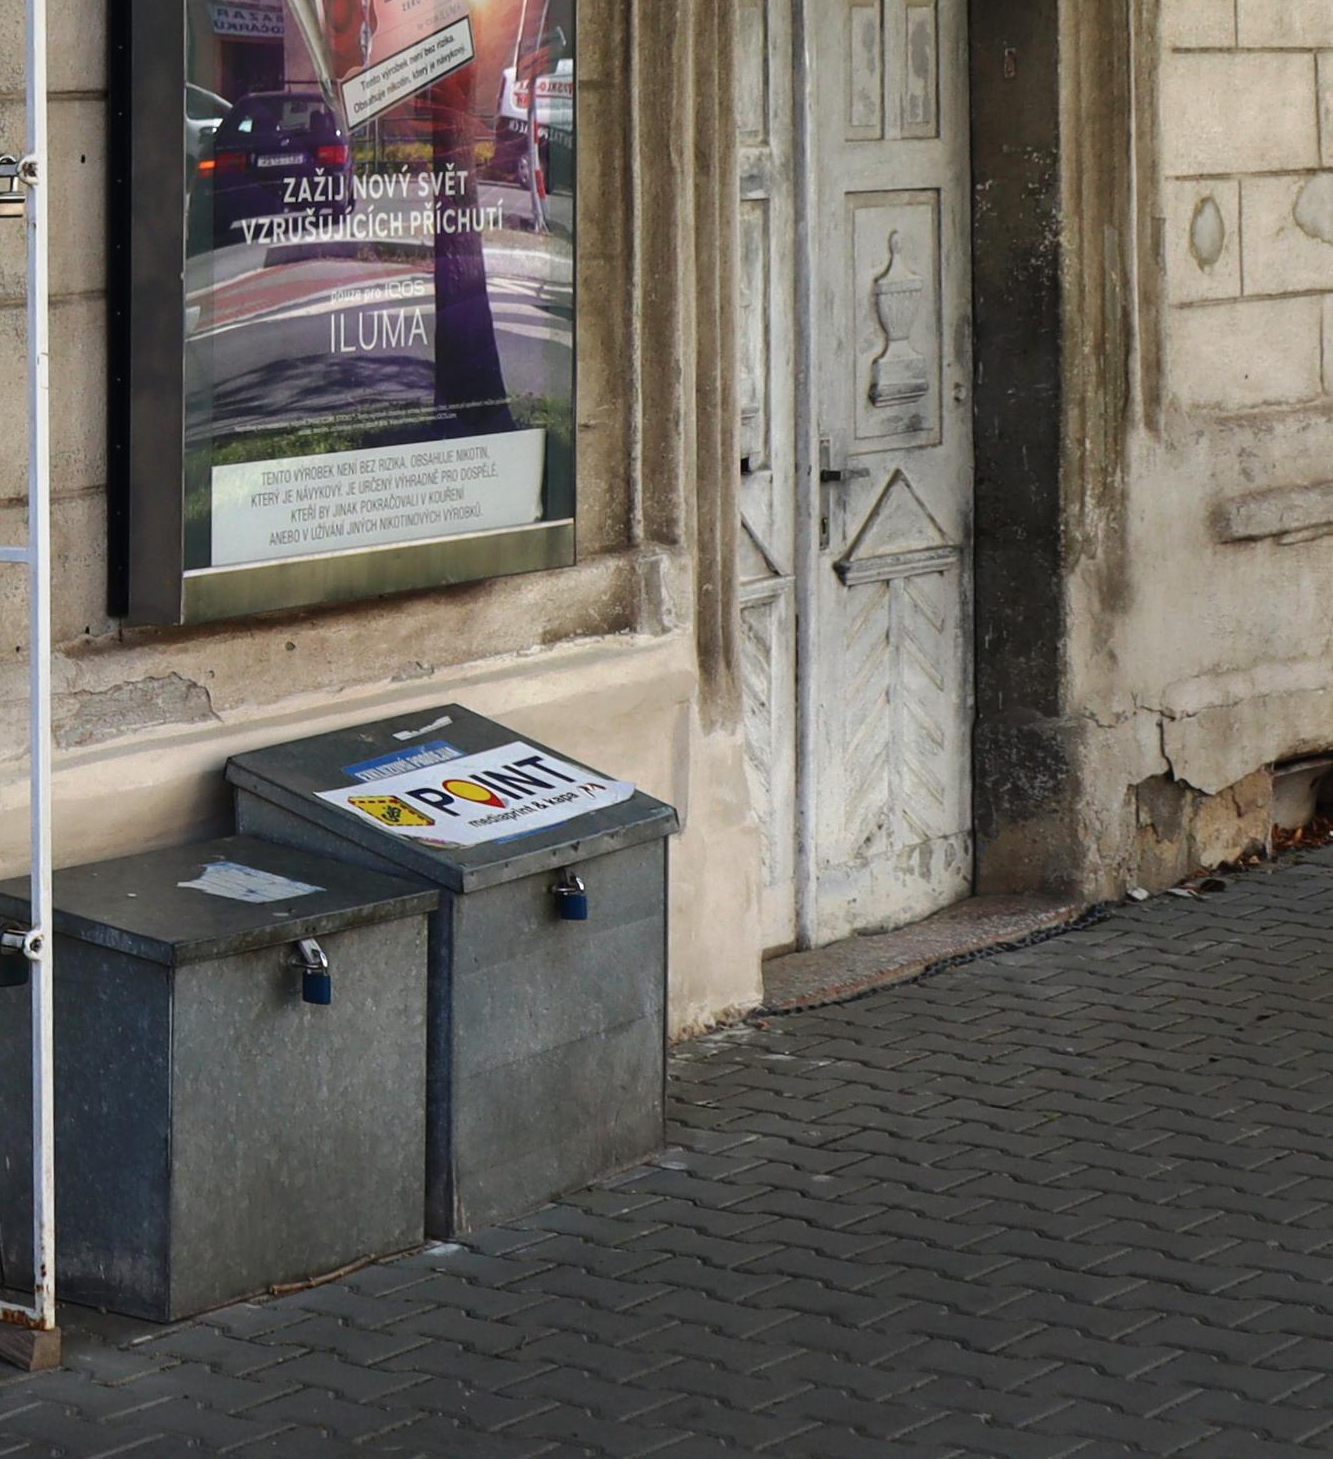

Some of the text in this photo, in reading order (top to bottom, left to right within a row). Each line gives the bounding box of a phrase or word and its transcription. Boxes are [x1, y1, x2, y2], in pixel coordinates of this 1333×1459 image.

[424, 44, 436, 57] bez
[283, 162, 469, 204] ZAŽIJ NOVÝ SVĚT
[241, 198, 505, 246] VZRUŠUJÍCÍCH PŘÍCHUTÍ
[363, 288, 382, 304] pro
[384, 280, 426, 299] IQOS
[330, 308, 429, 355] ILUMA
[260, 470, 293, 487] TENTO
[293, 464, 337, 483] VÝROBEK
[337, 461, 358, 477] NENÍ
[360, 459, 376, 475] BEZ
[410, 450, 454, 469] OBSAHUJE
[251, 487, 280, 509] KTERÝ
[283, 492, 294, 505] JE
[346, 482, 356, 496] JE
[358, 475, 393, 495] URČENÝ
[441, 469, 459, 483] PRO
[291, 485, 465, 523] KTEŘÍ BY JINAK POKRAČOVALI V KOUŘENÍ
[269, 528, 301, 547] ANEBO
[302, 528, 309, 541] V
[311, 522, 345, 541] UŽÍVÁNÍ
[346, 517, 378, 536] JINÝCH
[380, 508, 443, 531] NIKOTINOVÝCH
[467, 791, 579, 829] mediaprint & kapa
